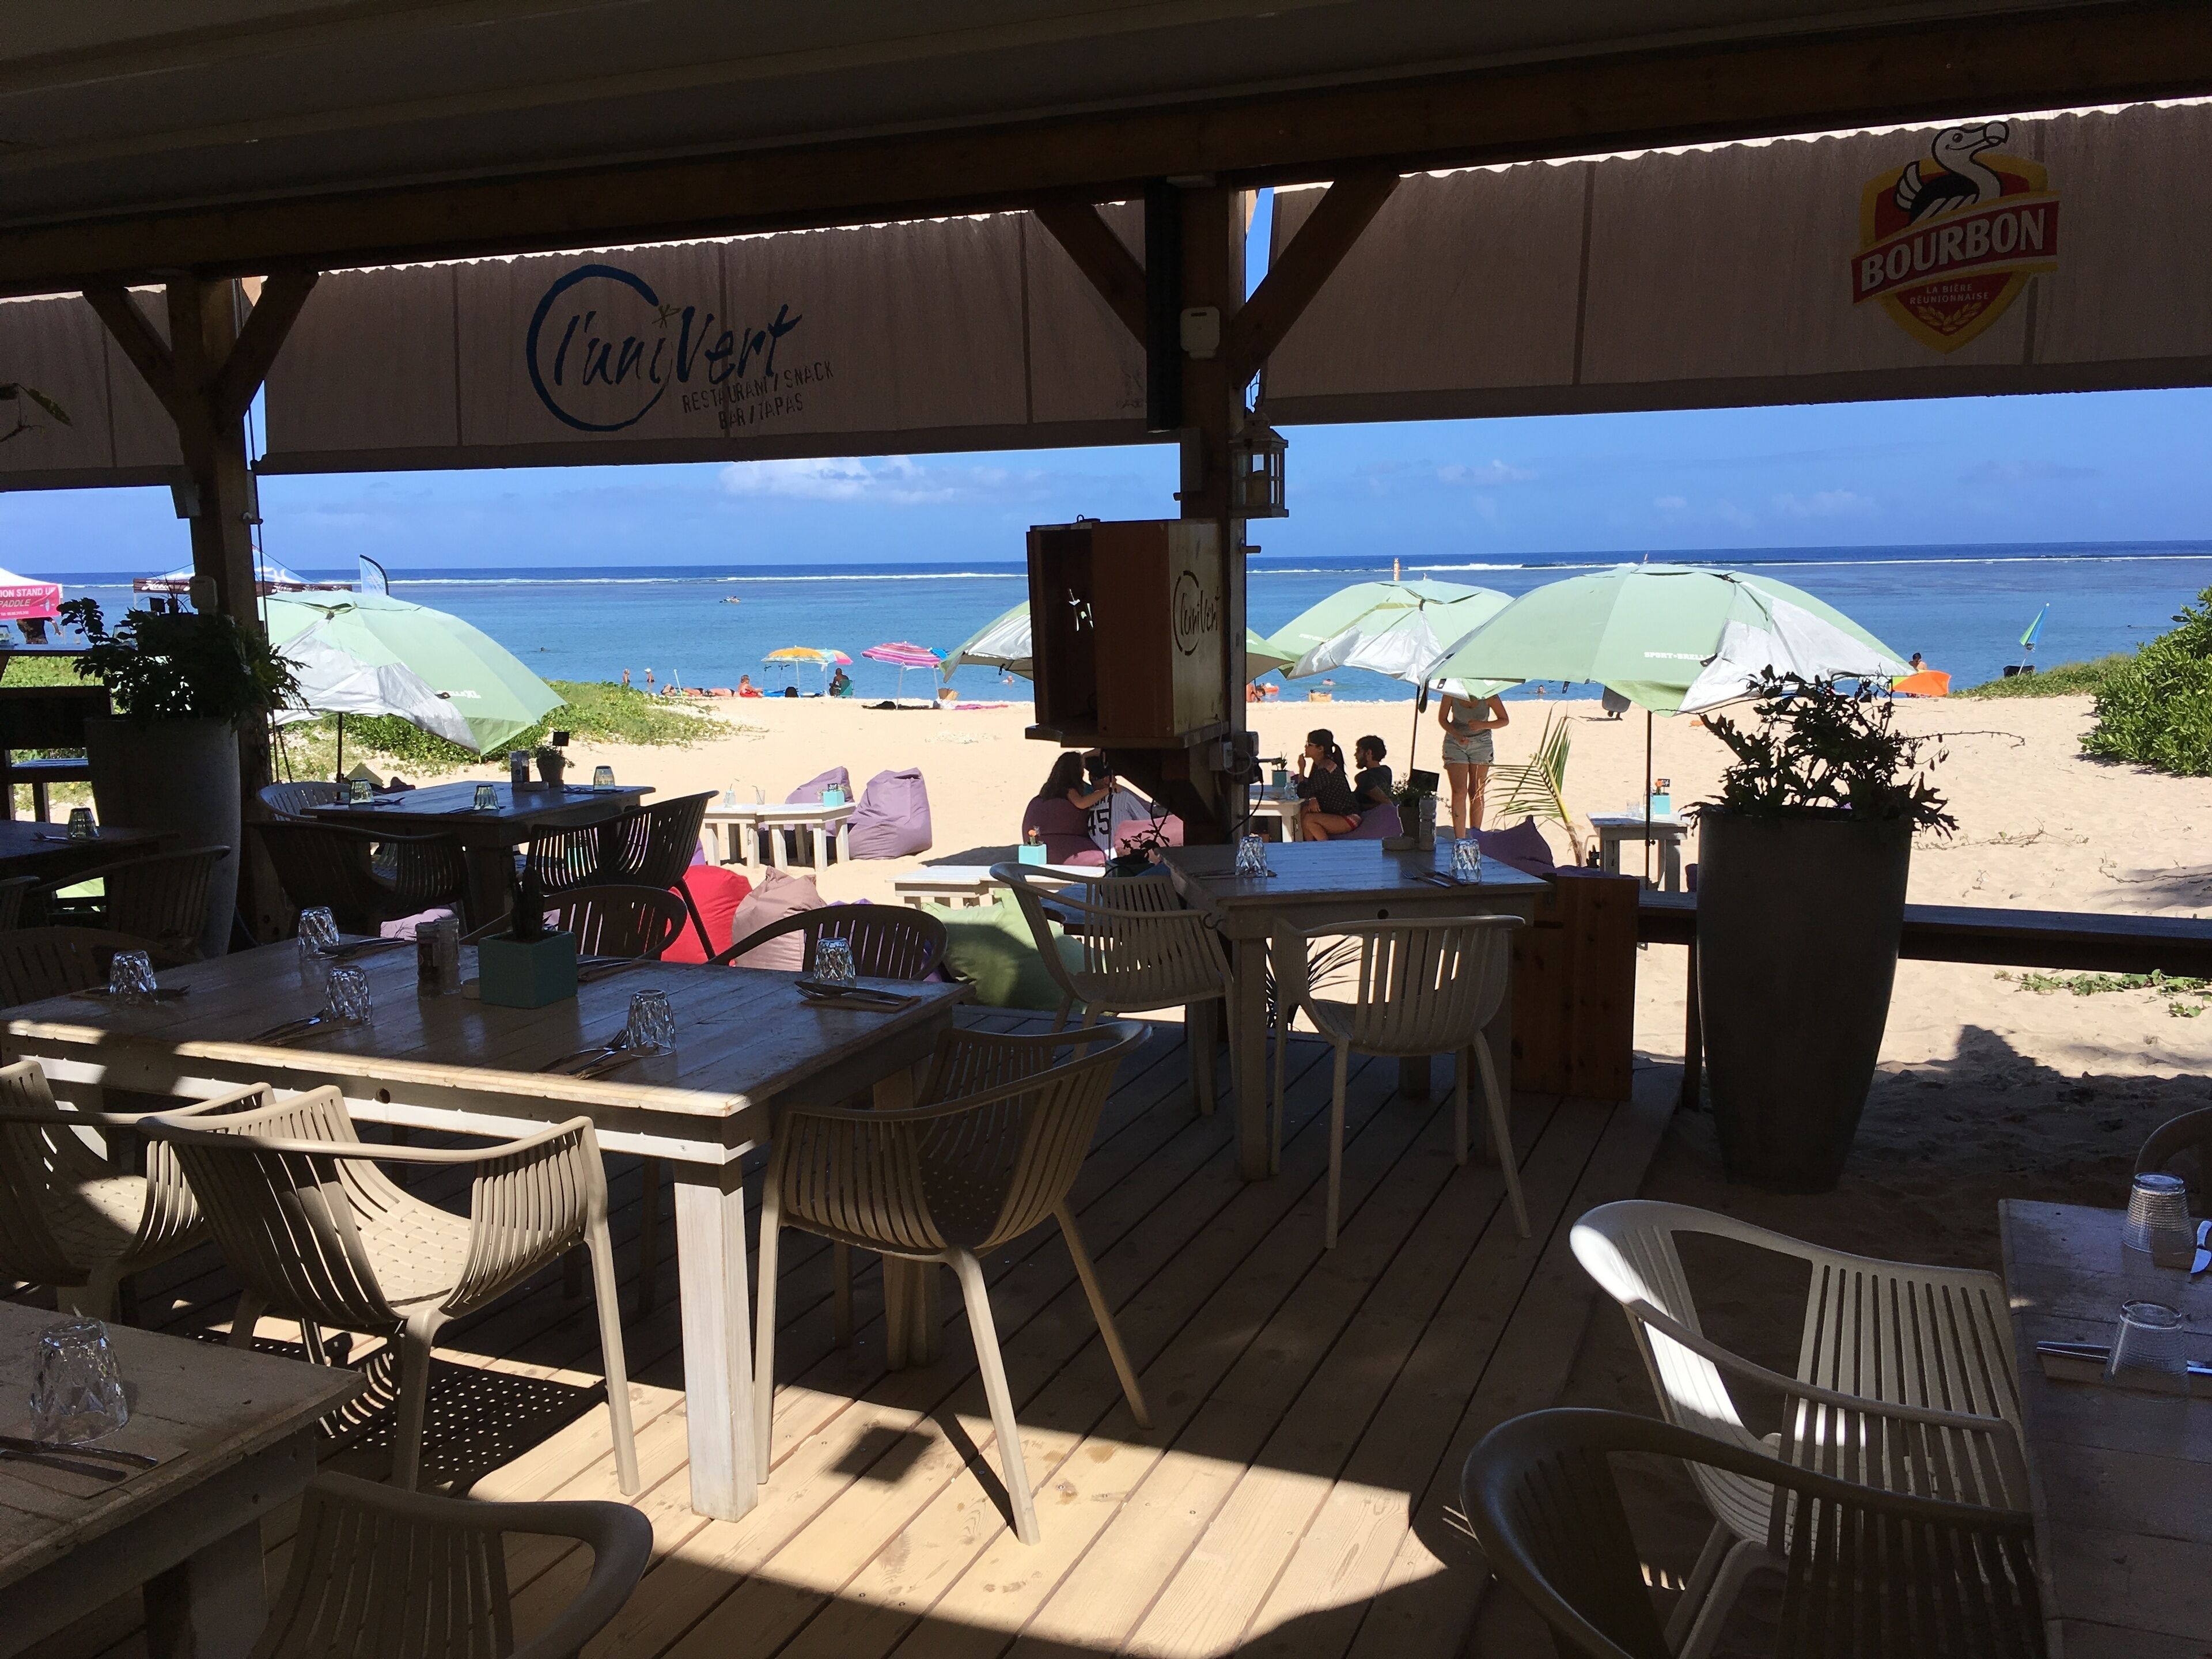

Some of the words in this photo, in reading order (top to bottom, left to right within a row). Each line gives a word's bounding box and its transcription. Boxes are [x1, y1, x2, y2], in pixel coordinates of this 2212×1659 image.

[1861, 209, 2044, 291] BOURBON
[1926, 286, 1938, 294] LA
[1942, 283, 1973, 293] BIÈRE
[682, 376, 768, 413] RESTAURANT
[784, 361, 834, 389] SNACK
[718, 408, 745, 430] BAR
[758, 393, 804, 421] TAPAS
[0, 589, 14, 597] ION
[16, 588, 43, 597] STAND
[1088, 809, 1111, 836] 45
